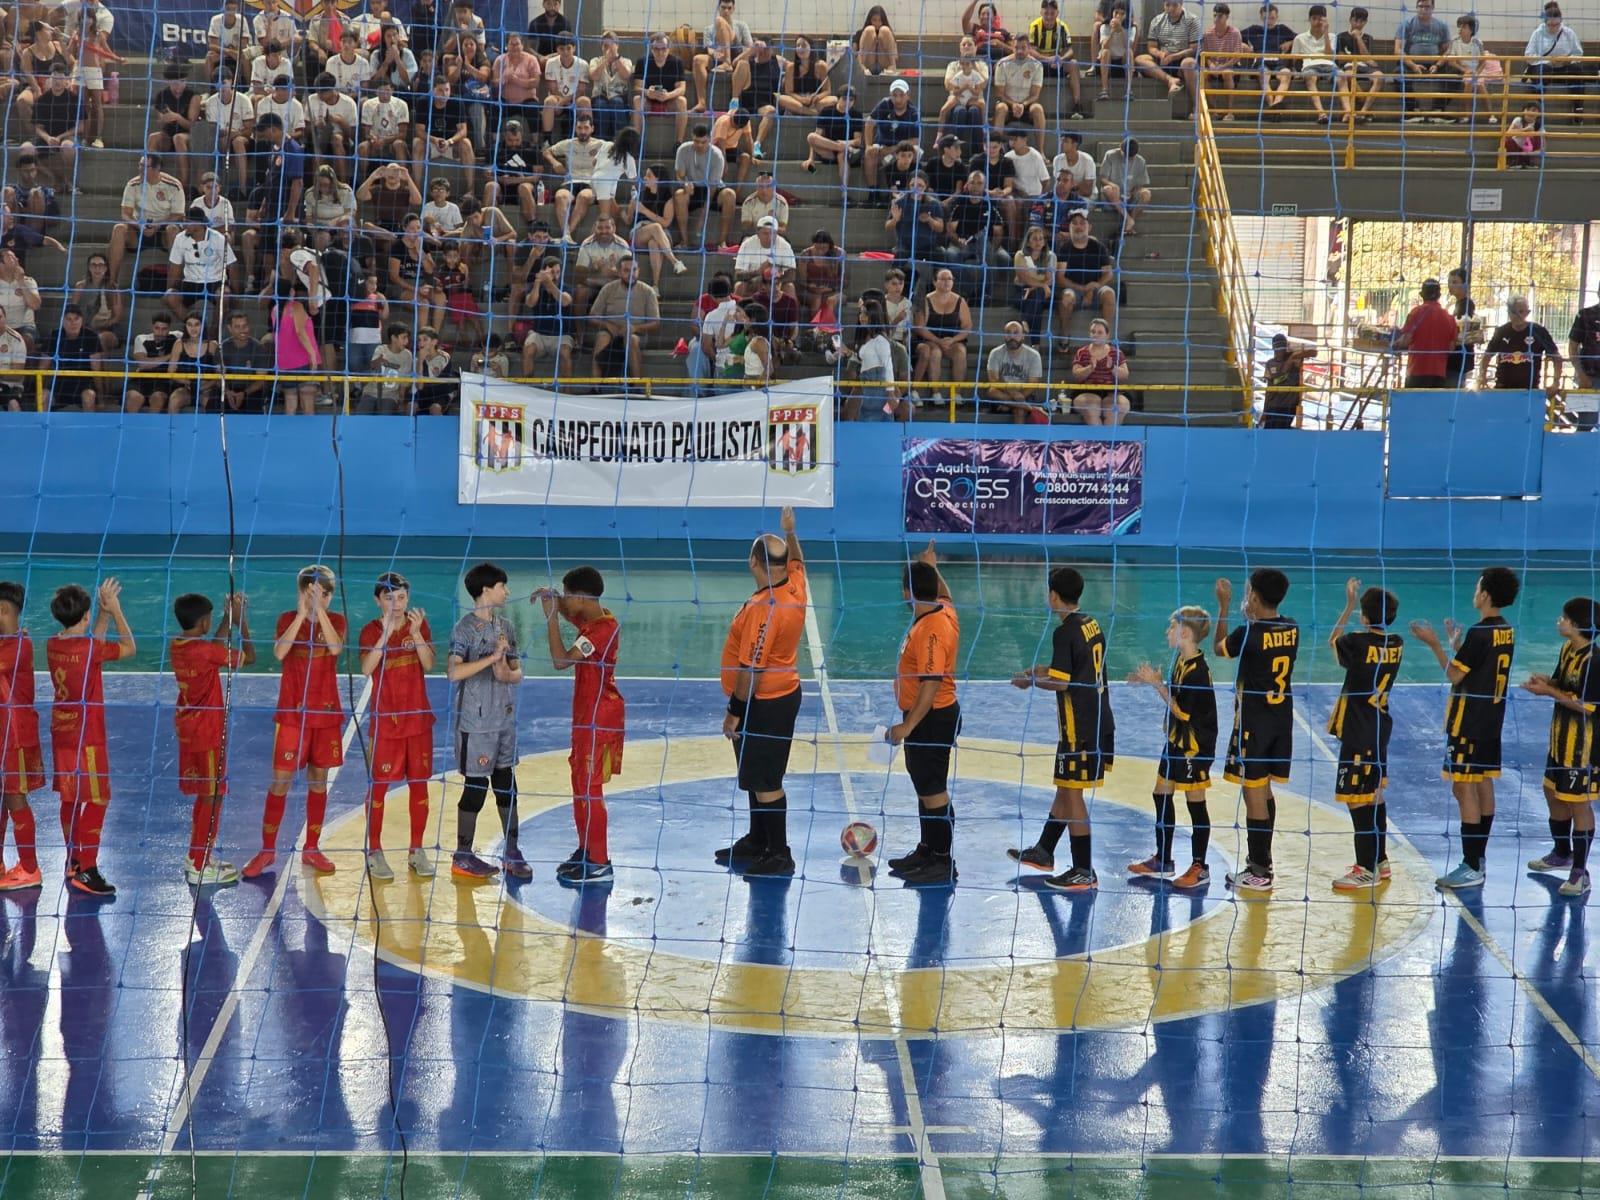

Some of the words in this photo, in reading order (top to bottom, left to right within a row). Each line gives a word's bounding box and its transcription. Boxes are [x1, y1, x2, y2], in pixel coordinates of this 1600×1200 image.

[477, 405, 520, 419] FPFS
[772, 408, 814, 422] FPFS
[532, 418, 666, 463] CAMPEONATO
[671, 420, 763, 463] PAULISTA
[936, 462, 963, 475] Aqui
[914, 476, 1010, 499] CROSS
[1047, 482, 1077, 493] 0800
[1078, 482, 1099, 493] 774
[1101, 482, 1129, 493] 4244
[1034, 496, 1129, 505] crossconection.com.br
[1266, 655, 1290, 705] 3
[1059, 761, 1065, 775] 8
[1186, 765, 1193, 779] 2
[1338, 775, 1345, 789] 4
[1569, 776, 1577, 790] 7
